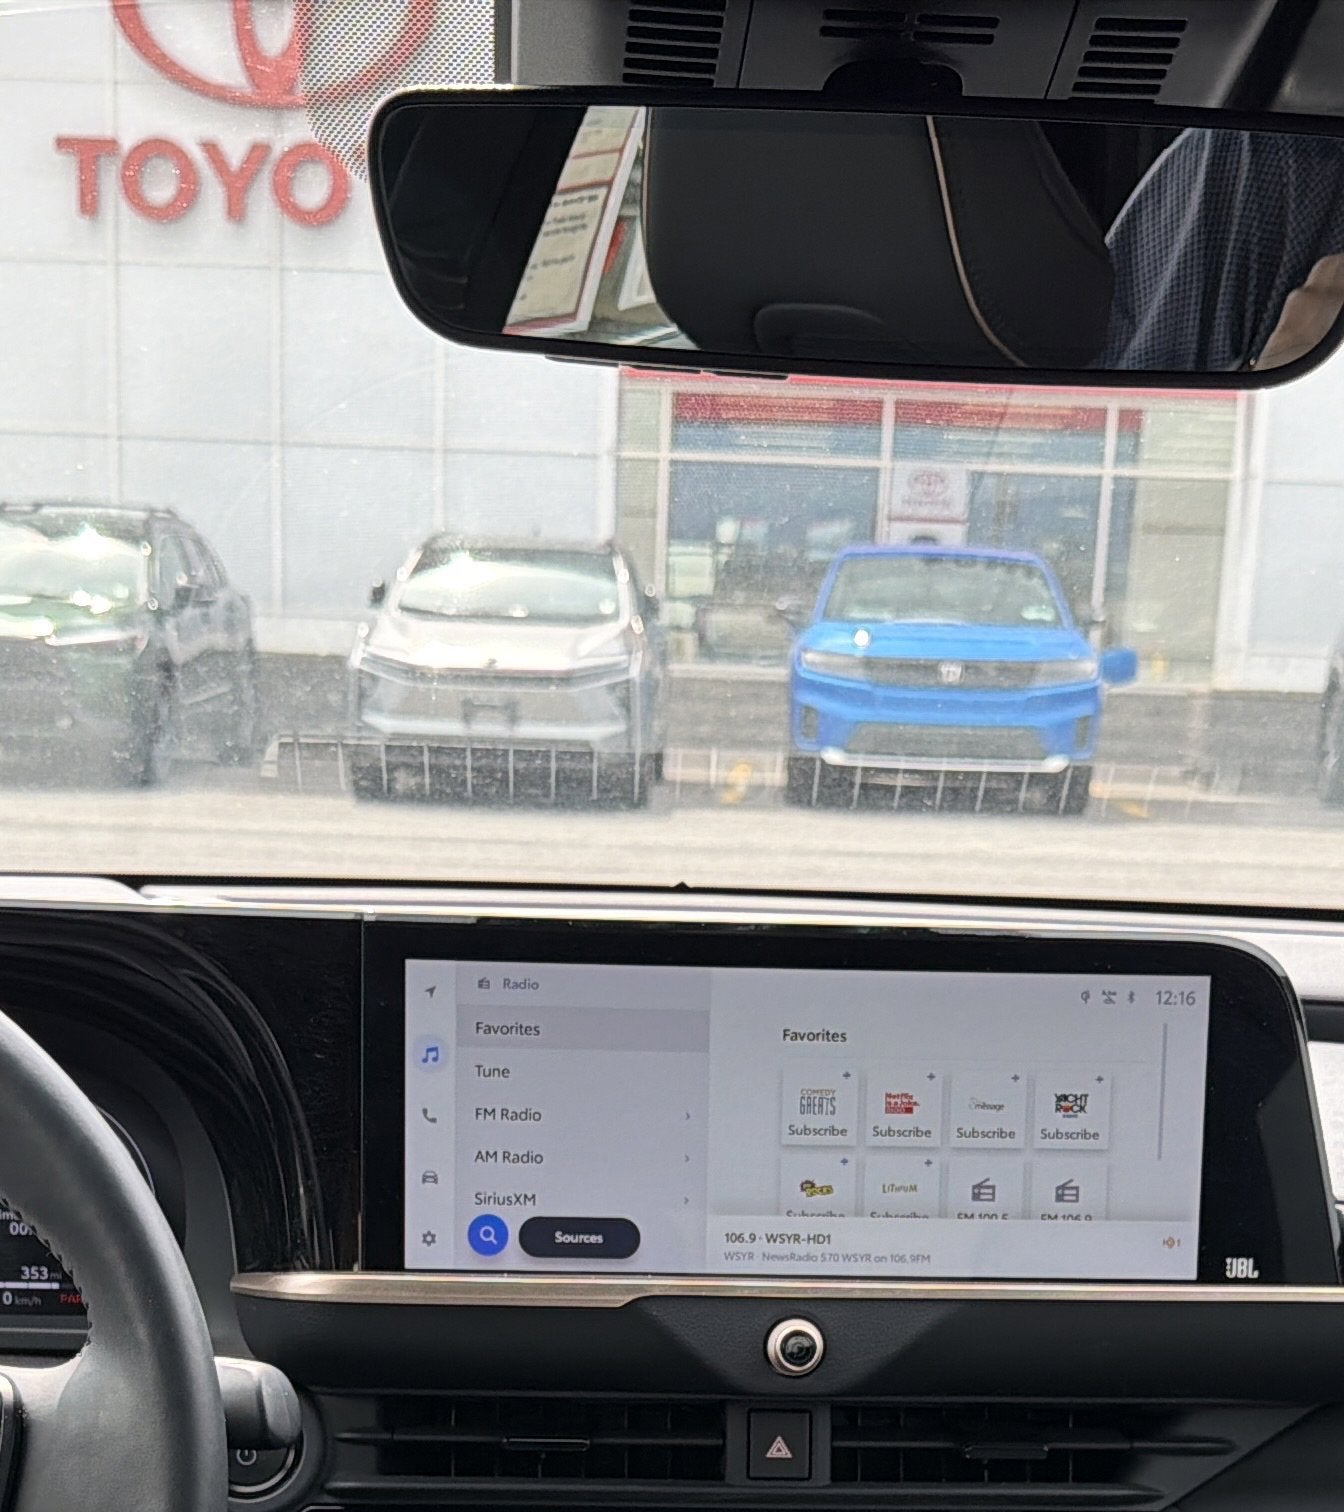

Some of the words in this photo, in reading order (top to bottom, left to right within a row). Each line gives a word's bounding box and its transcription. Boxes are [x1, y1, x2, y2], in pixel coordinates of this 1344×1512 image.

[54, 136, 356, 227] TOYO
[503, 978, 539, 991] Radio
[1156, 990, 1196, 1006] 12:16
[475, 1022, 541, 1036] Favorites
[782, 1029, 847, 1044] Favorites
[475, 1065, 511, 1079] Tune
[475, 1108, 497, 1121] FM
[500, 1108, 542, 1122] Radio
[788, 1124, 848, 1138] Subscribe
[872, 1125, 932, 1139] Subscribe
[956, 1127, 1016, 1140] Subscribe
[1040, 1128, 1100, 1141] Subscribe
[475, 1151, 498, 1164] AM
[502, 1151, 544, 1165] Radio
[475, 1193, 537, 1206] SiriusXM
[555, 1231, 604, 1245] Sources
[725, 1232, 756, 1244] 106.9
[765, 1233, 831, 1245] WSYR-HD1
[724, 1252, 754, 1261] WSYR
[762, 1252, 818, 1262] NewsRadio
[842, 1253, 872, 1263] WSYR
[874, 1255, 887, 1263] on
[20, 1265, 49, 1280] 353
[1225, 1257, 1259, 1279] JBL
[2, 1291, 13, 1306] 0
